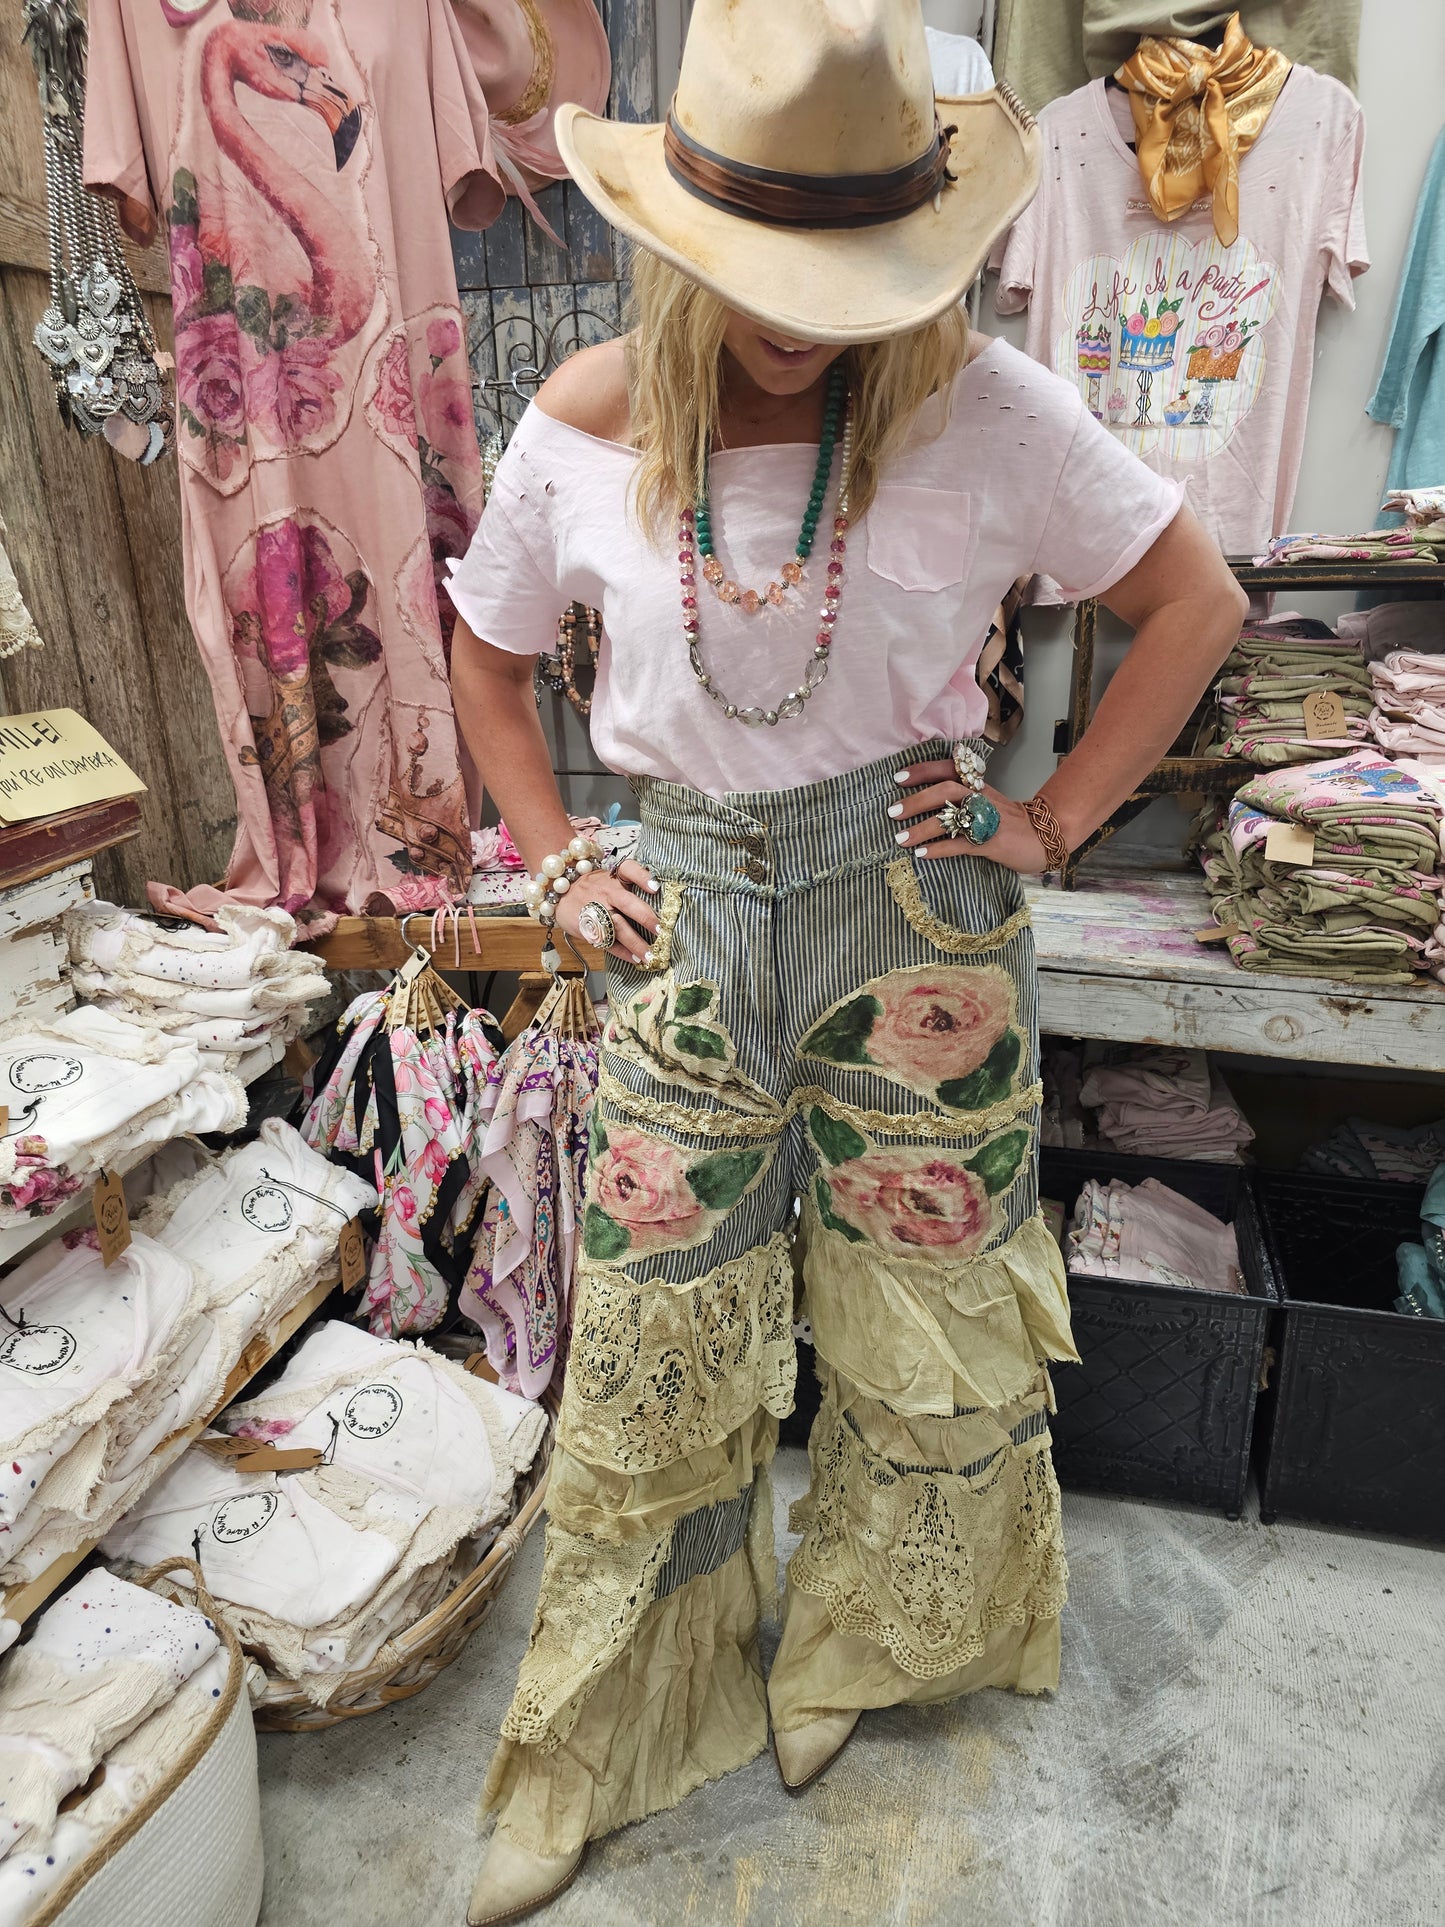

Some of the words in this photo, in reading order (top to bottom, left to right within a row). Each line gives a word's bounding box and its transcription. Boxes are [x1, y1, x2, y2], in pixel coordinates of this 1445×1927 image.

[1082, 270, 1136, 322] Life
[1145, 257, 1168, 295] Is
[1176, 270, 1192, 290] a
[0, 718, 68, 758] MILE!
[43, 762, 67, 779] ON
[62, 751, 118, 776] CAMERA
[358, 1424, 381, 1434] Rare
[226, 1527, 249, 1536] Rare
